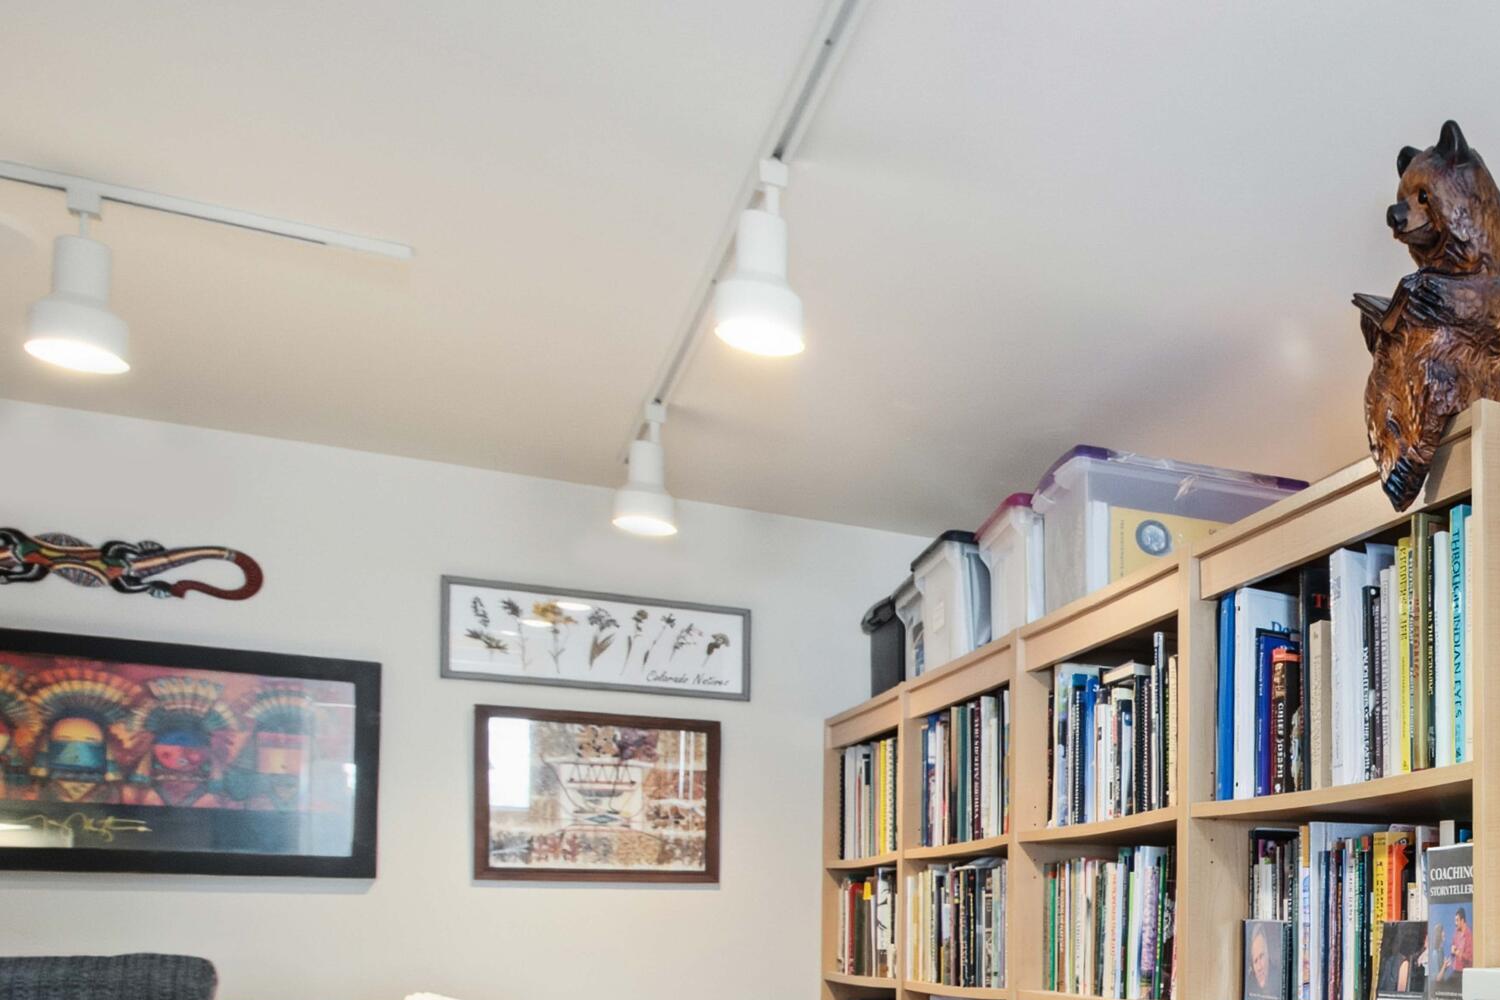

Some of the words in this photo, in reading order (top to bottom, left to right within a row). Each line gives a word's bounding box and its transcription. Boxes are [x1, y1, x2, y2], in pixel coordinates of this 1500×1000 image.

[1453, 614, 1461, 676] INDIAN
[1454, 681, 1462, 718] EYES
[1277, 702, 1285, 736] CHIEF
